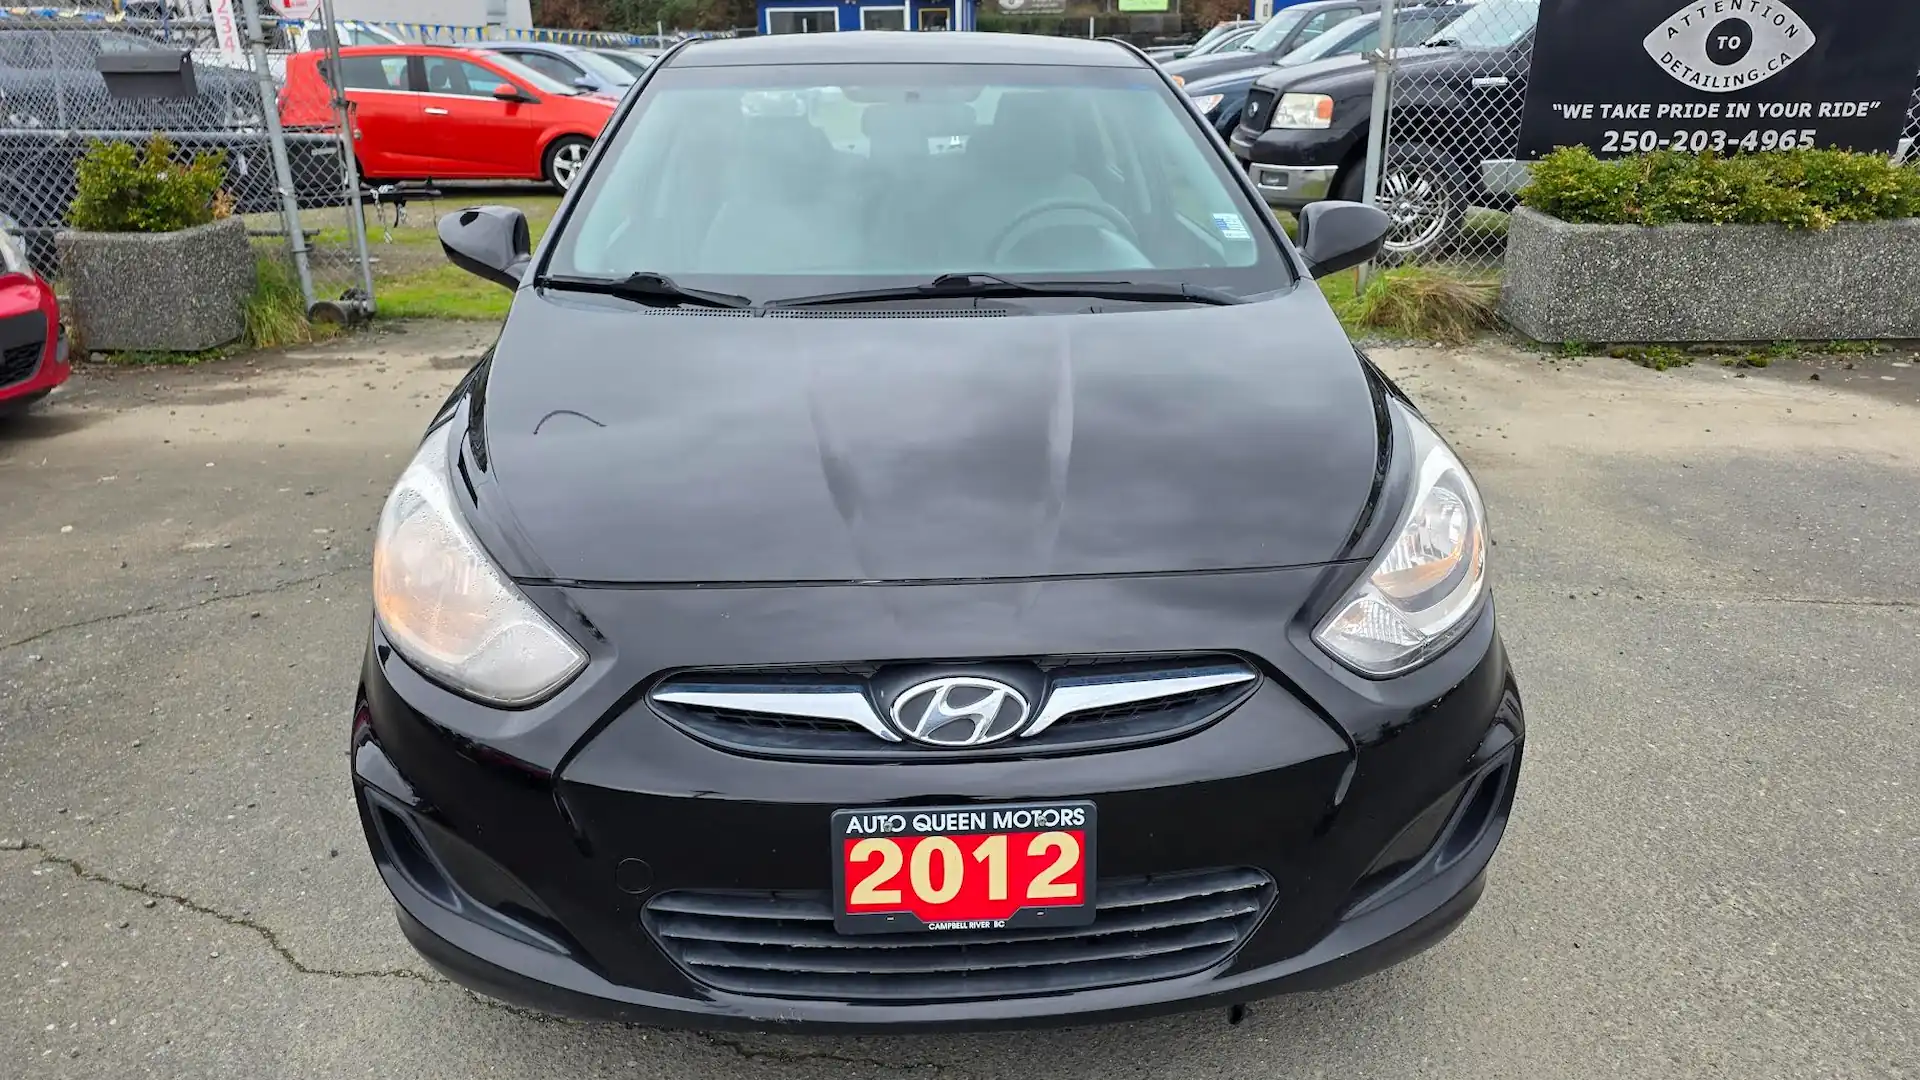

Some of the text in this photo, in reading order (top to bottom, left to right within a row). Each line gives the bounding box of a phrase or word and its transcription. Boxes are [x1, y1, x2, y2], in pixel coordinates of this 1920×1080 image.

[1666, 0, 1799, 40] ATTENTION
[1717, 36, 1741, 50] TO
[1660, 51, 1792, 89] DETAILING.CA
[1600, 103, 1651, 119] TAKE
[1656, 103, 1720, 118] PRIDE
[1725, 103, 1751, 118] IN
[1757, 102, 1812, 118] YOUR
[1600, 129, 1816, 152] 250-203-4965
[846, 808, 1085, 834] AUTO QUEEN MOTORS
[849, 831, 1081, 905] 2012
[928, 920, 1006, 931] CAMPBELL RIVER BC
